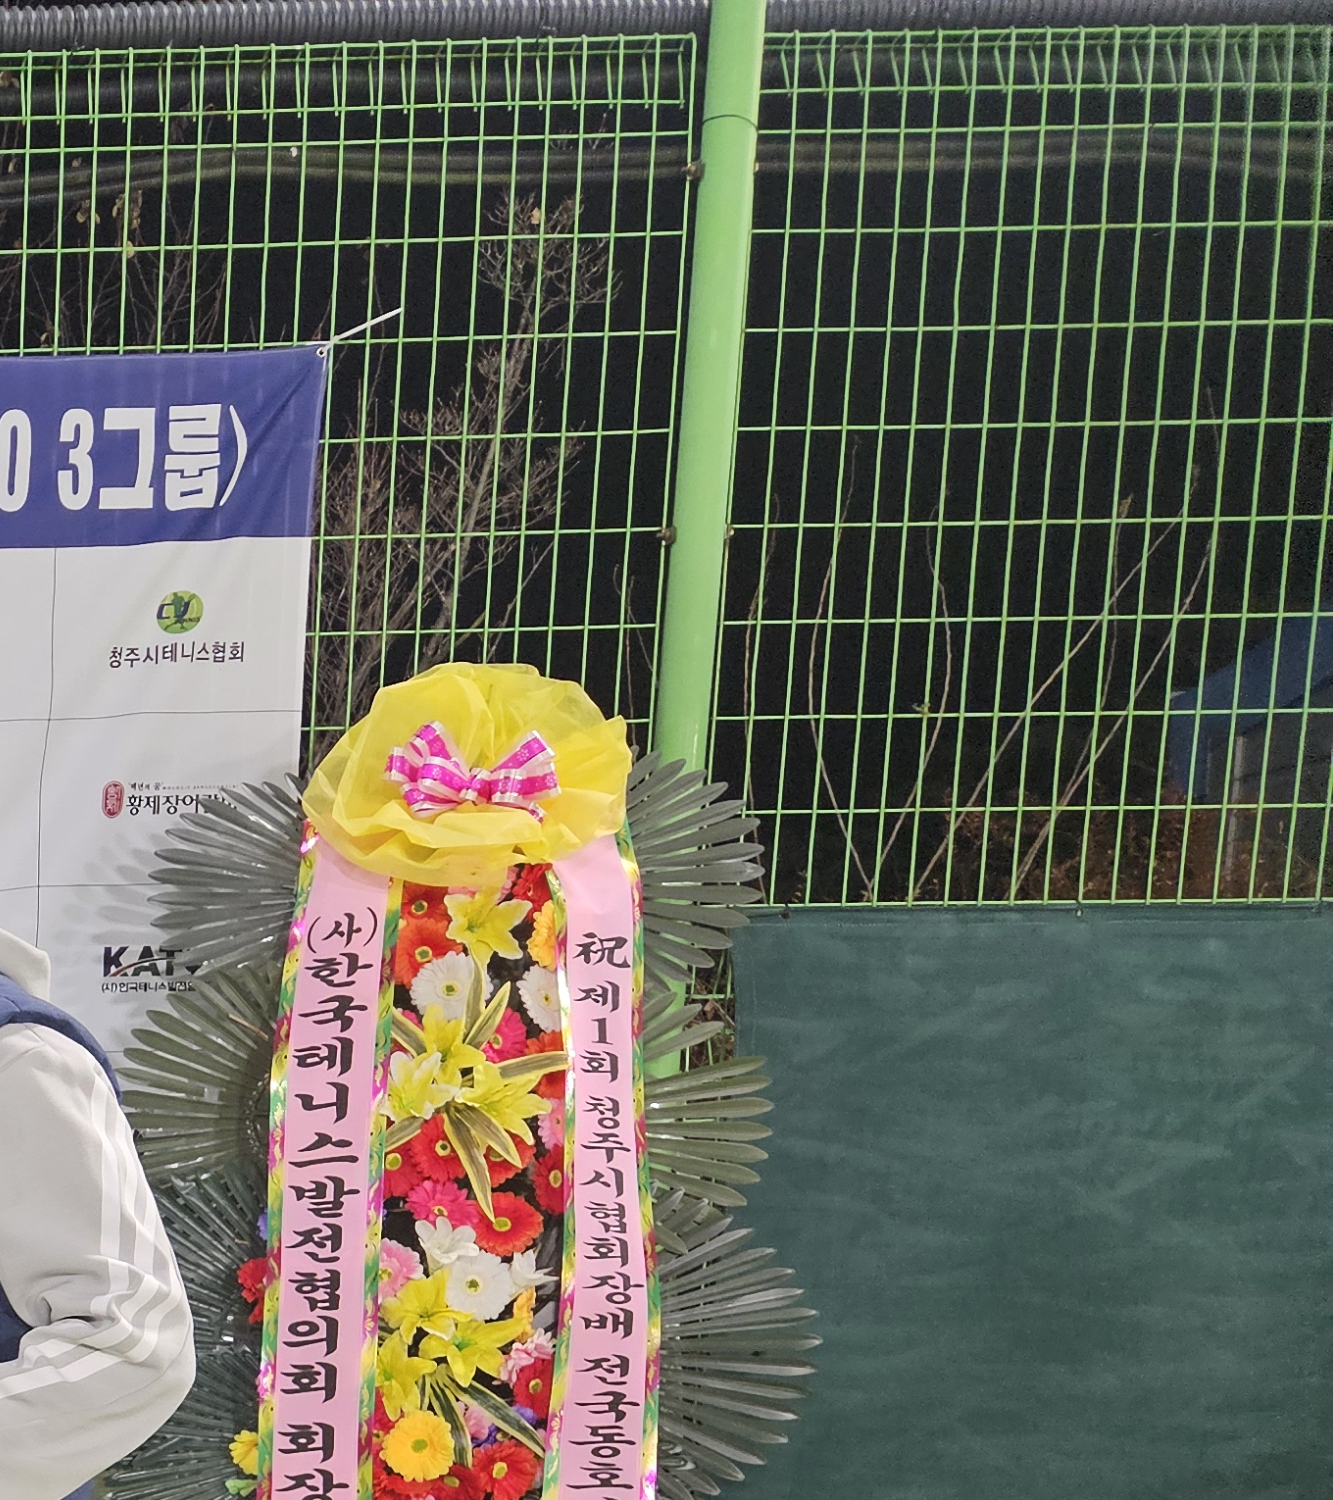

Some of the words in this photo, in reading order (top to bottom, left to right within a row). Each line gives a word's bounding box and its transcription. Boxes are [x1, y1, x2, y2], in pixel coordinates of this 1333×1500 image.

[56, 402, 250, 513] 3그룹)
[109, 641, 246, 669] 청주시테니스협회
[126, 795, 237, 816] 황제장어
[103, 946, 201, 977] KAT
[572, 932, 632, 970] 祝
[571, 981, 624, 1083] 제1회
[279, 907, 379, 1402] (사)한국테니스발전협의회
[579, 1095, 646, 1340] 청주시협회장배
